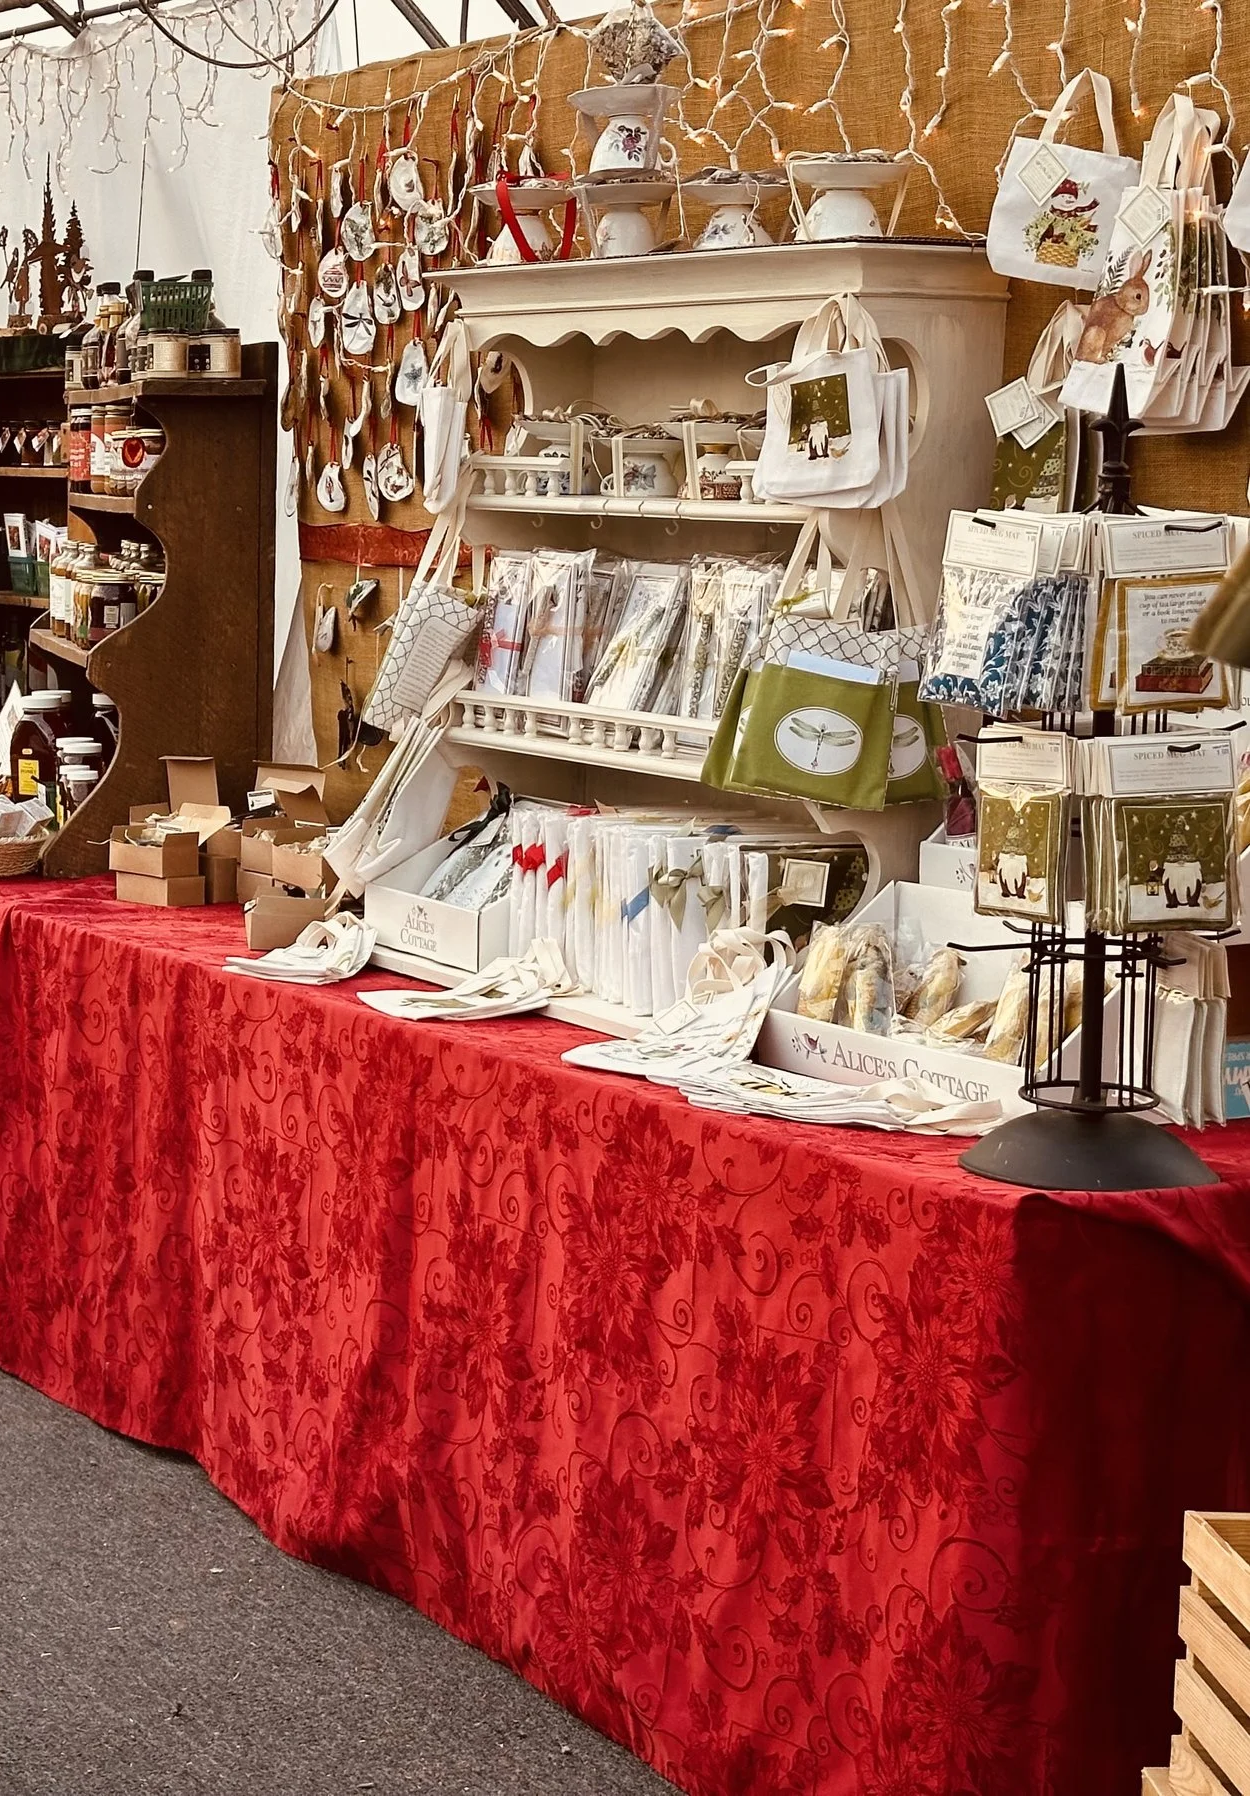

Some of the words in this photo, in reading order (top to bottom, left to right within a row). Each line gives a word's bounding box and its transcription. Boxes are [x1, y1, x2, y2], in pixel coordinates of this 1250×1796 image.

[1132, 530, 1162, 539] SPICED
[1133, 751, 1164, 760] SPICED
[405, 912, 434, 935] ALICE'S
[400, 928, 437, 952] COTTAGE
[831, 1040, 898, 1079] ALICE'S
